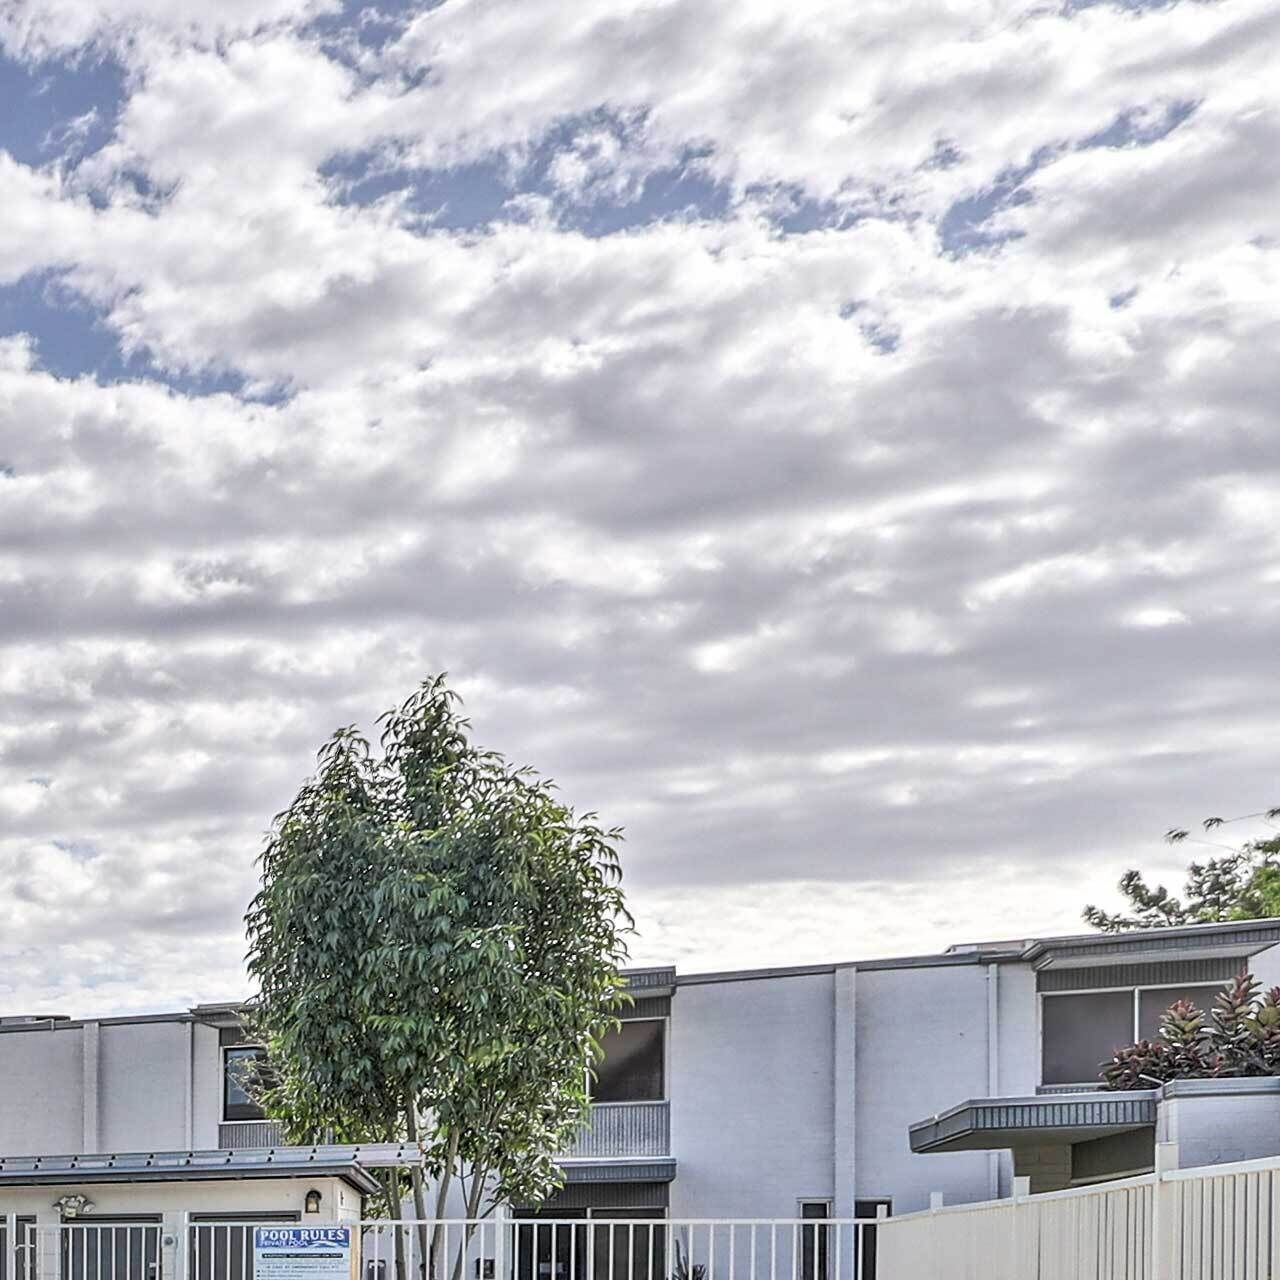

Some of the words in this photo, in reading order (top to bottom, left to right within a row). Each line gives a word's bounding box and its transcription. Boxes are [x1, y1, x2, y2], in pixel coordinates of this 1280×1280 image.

[260, 1230, 297, 1241] POOL
[301, 1230, 345, 1241] RULES
[259, 1240, 286, 1248] PRIVATE
[288, 1240, 309, 1248] POOL
